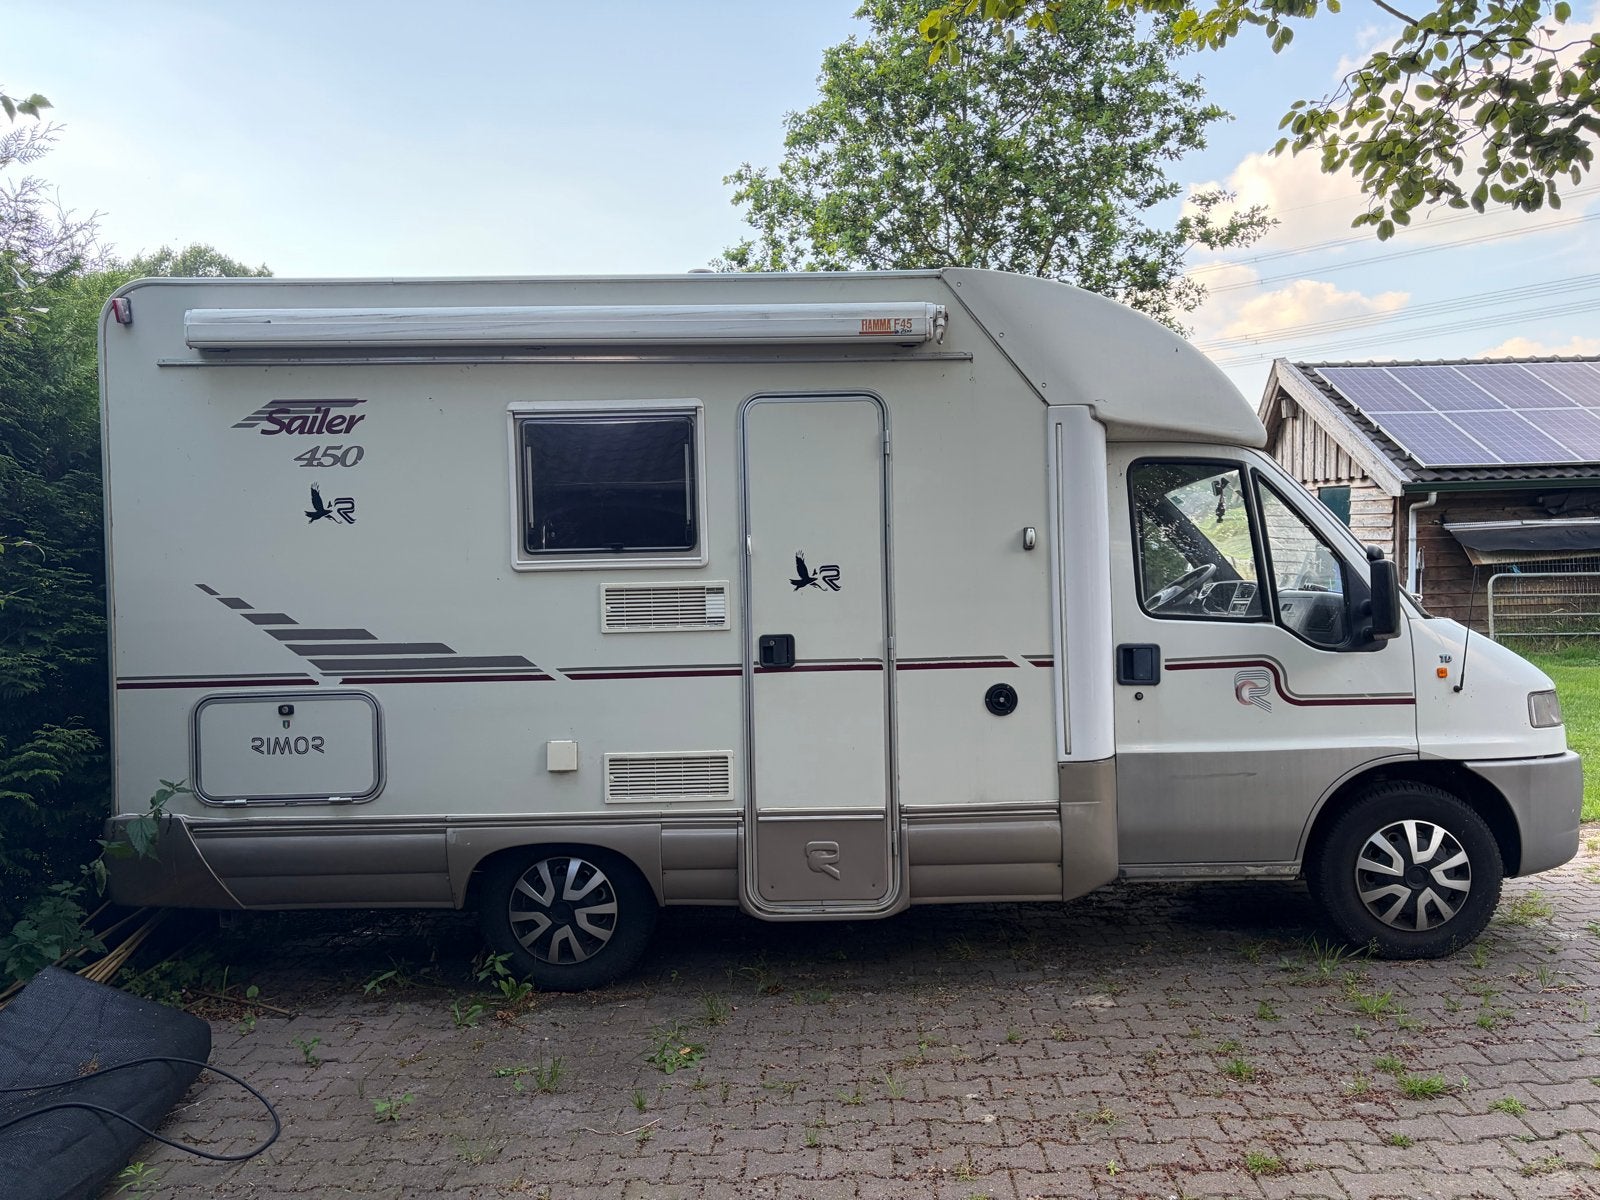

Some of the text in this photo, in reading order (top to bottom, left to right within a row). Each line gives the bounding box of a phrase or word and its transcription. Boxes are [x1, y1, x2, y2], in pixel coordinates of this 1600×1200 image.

[894, 319, 913, 329] F45
[260, 406, 366, 435] Sailer
[293, 444, 365, 468] 450
[251, 736, 325, 755] RIMOR
